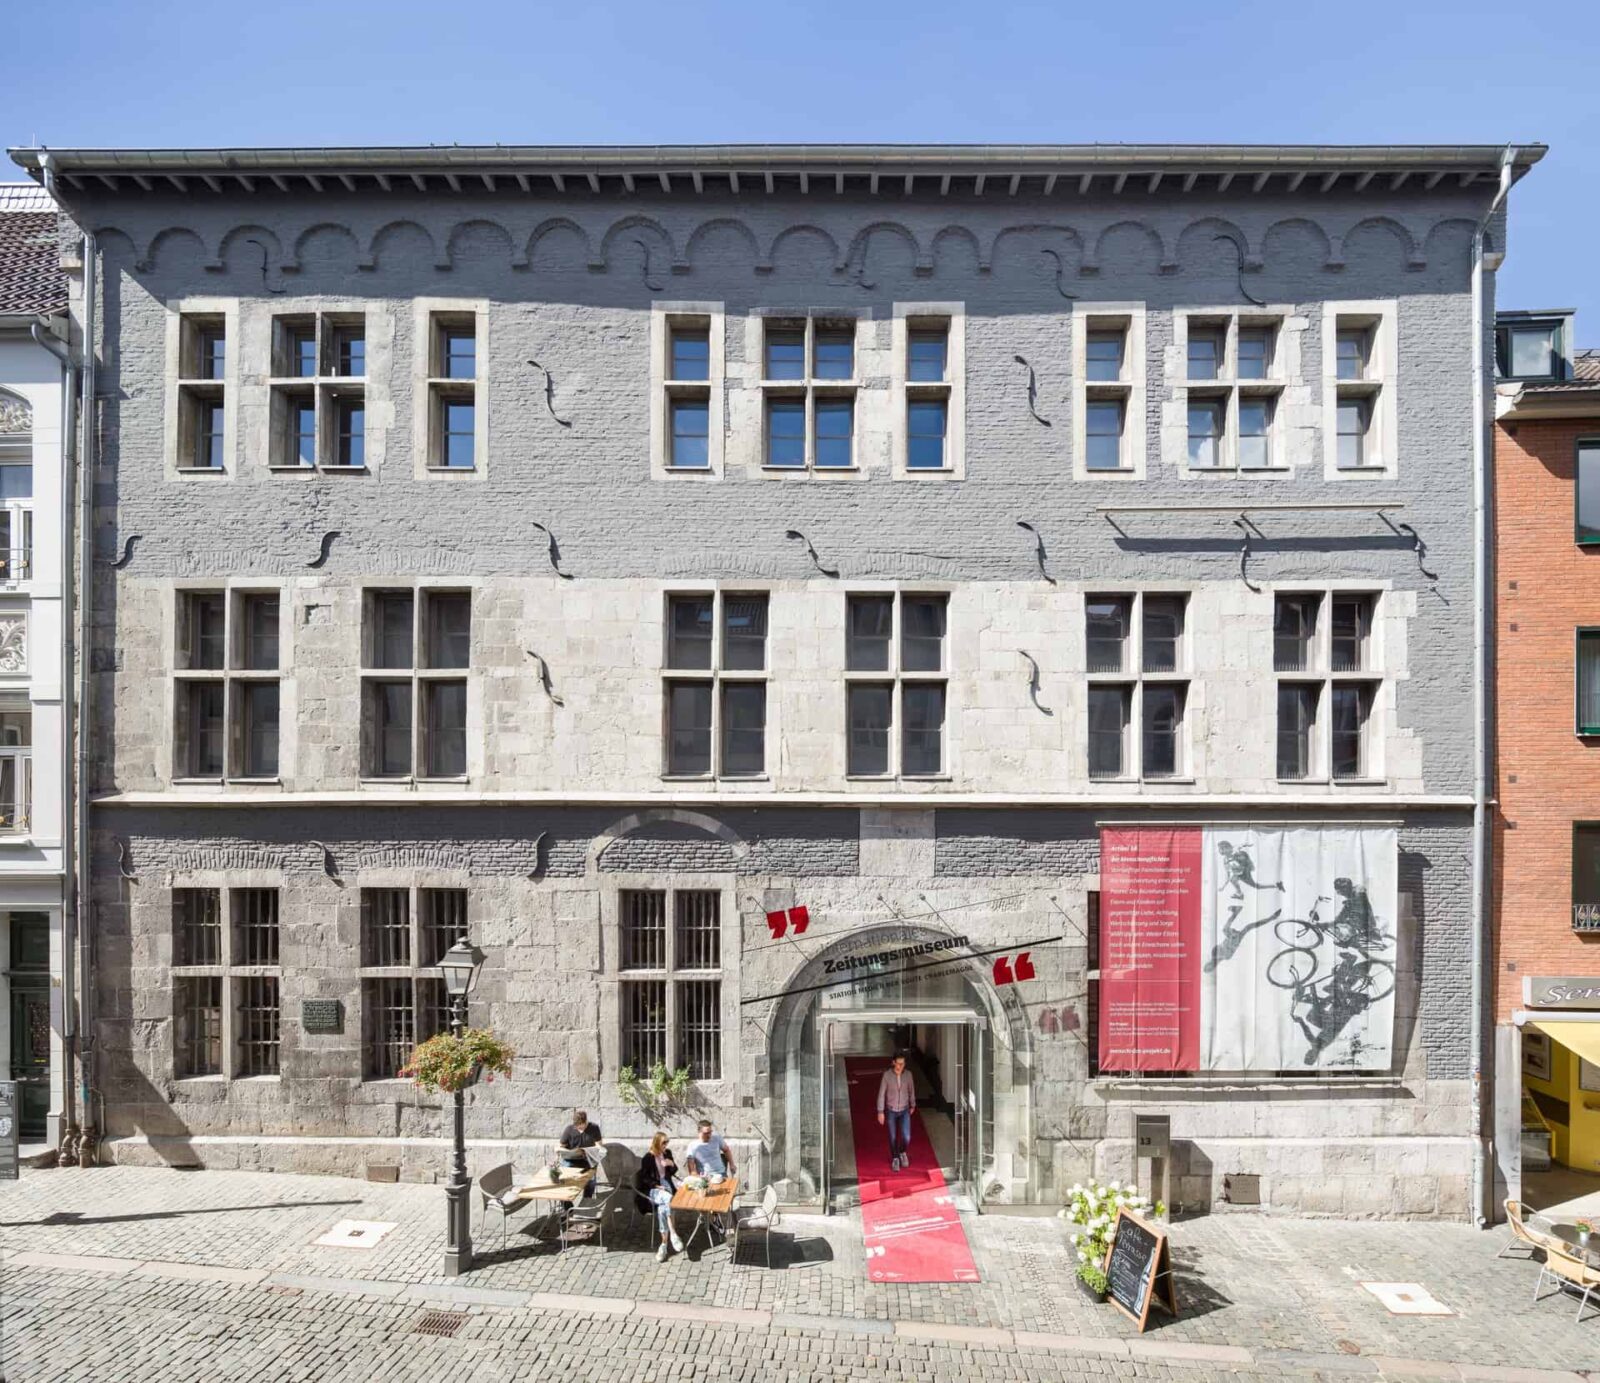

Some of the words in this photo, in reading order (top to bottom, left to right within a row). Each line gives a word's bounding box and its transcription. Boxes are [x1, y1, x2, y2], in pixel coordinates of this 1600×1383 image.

[824, 935, 970, 973] Zeitungsmuseum
[829, 988, 857, 999] STATION
[924, 964, 974, 981] CHARLEMAGNE
[1140, 1136, 1151, 1145] 13
